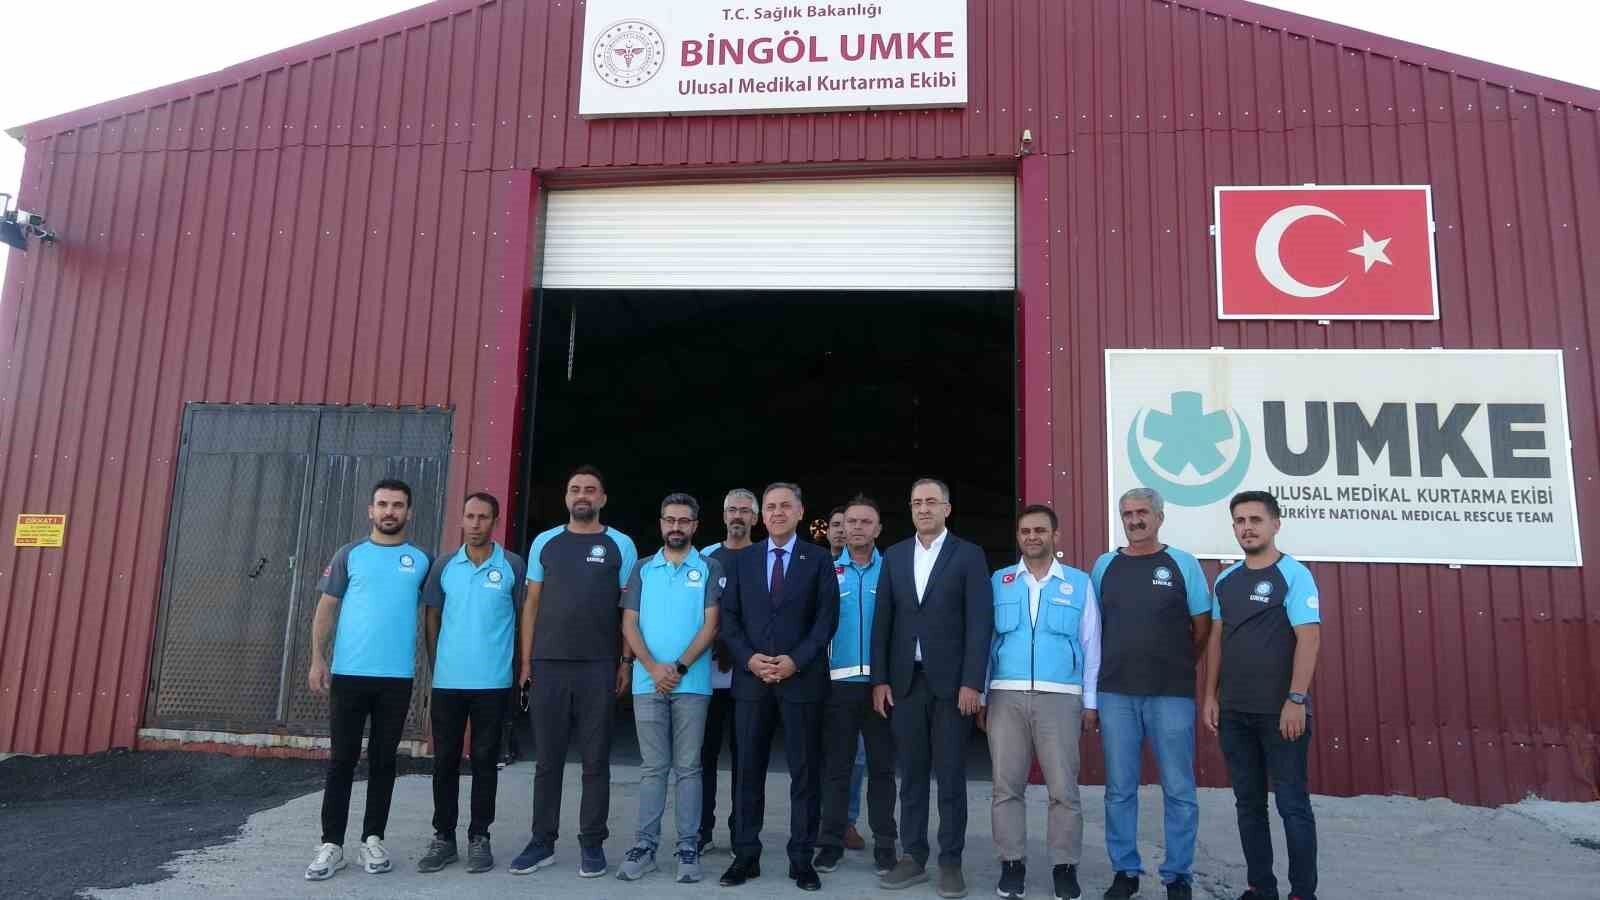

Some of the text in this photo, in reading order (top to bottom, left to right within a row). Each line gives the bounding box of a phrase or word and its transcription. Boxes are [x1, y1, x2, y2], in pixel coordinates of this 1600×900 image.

[722, 3, 881, 22] T.C. Sağlık Bakanlığı
[681, 30, 828, 67] BİNGÖL
[840, 31, 954, 61] UMKE
[678, 72, 956, 95] Ulusal Medikal Kurtarma Ekibi
[1262, 400, 1551, 478] UMKE
[1337, 483, 1411, 502] MEDİKAL
[1417, 488, 1507, 504] KURTARMA
[1511, 486, 1553, 504] EKİBİ
[1278, 505, 1553, 523] ÜRKİYE NATIONAL MEDICAL RESCUE TEAM
